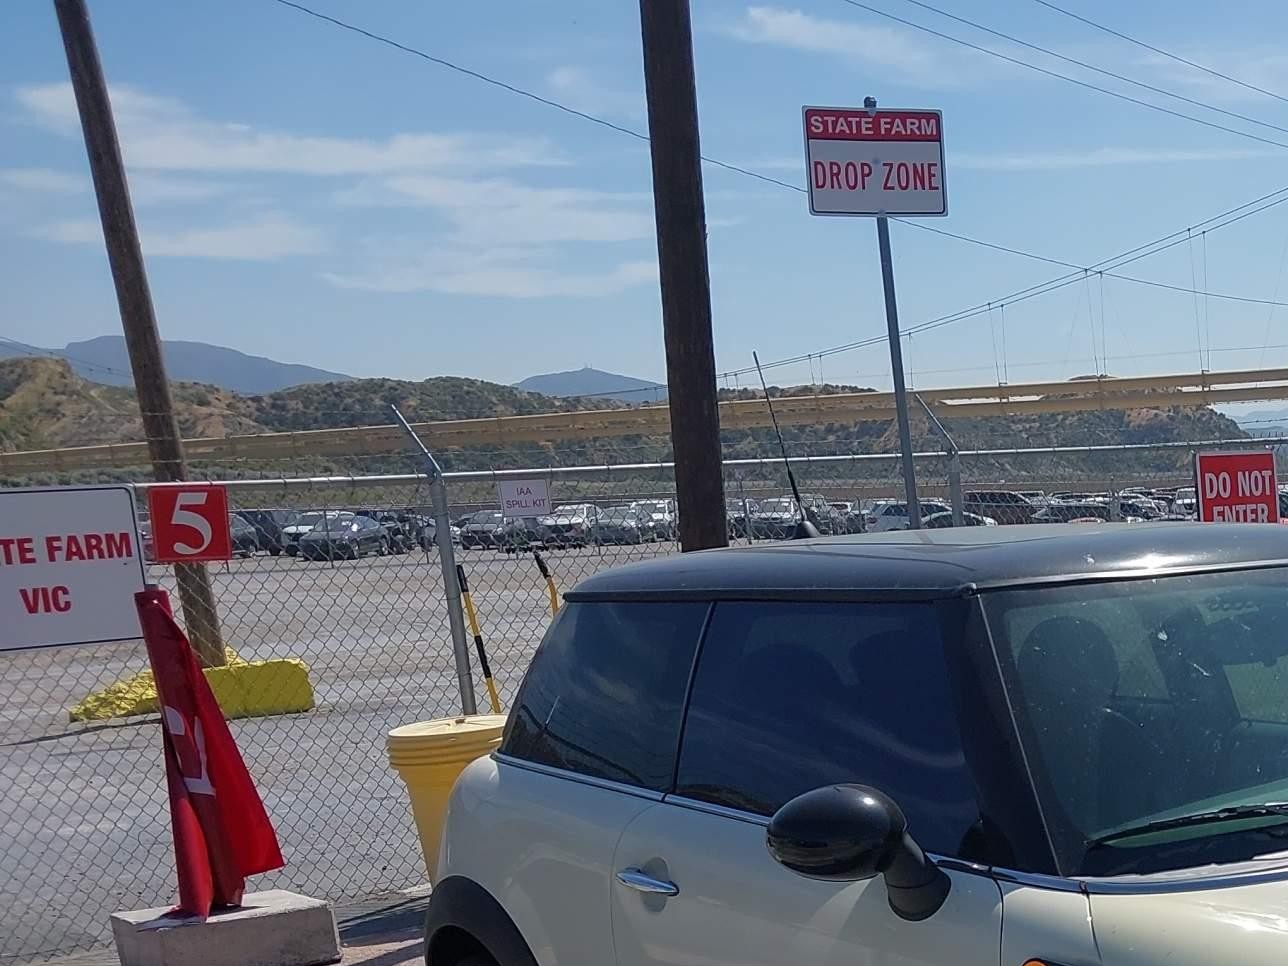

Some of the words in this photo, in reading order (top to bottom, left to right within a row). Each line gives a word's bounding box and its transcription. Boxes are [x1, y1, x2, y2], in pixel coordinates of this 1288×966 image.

[810, 115, 875, 135] STATE
[880, 117, 937, 136] FARM
[813, 160, 873, 191] DROP
[882, 161, 940, 191] ZONE
[1204, 471, 1231, 499] DO
[1237, 469, 1273, 497] NOT
[171, 492, 213, 555] 5
[1212, 503, 1269, 523] ENTER
[0, 538, 37, 566] TE
[45, 532, 133, 563] FARM
[19, 585, 72, 615] VIC
